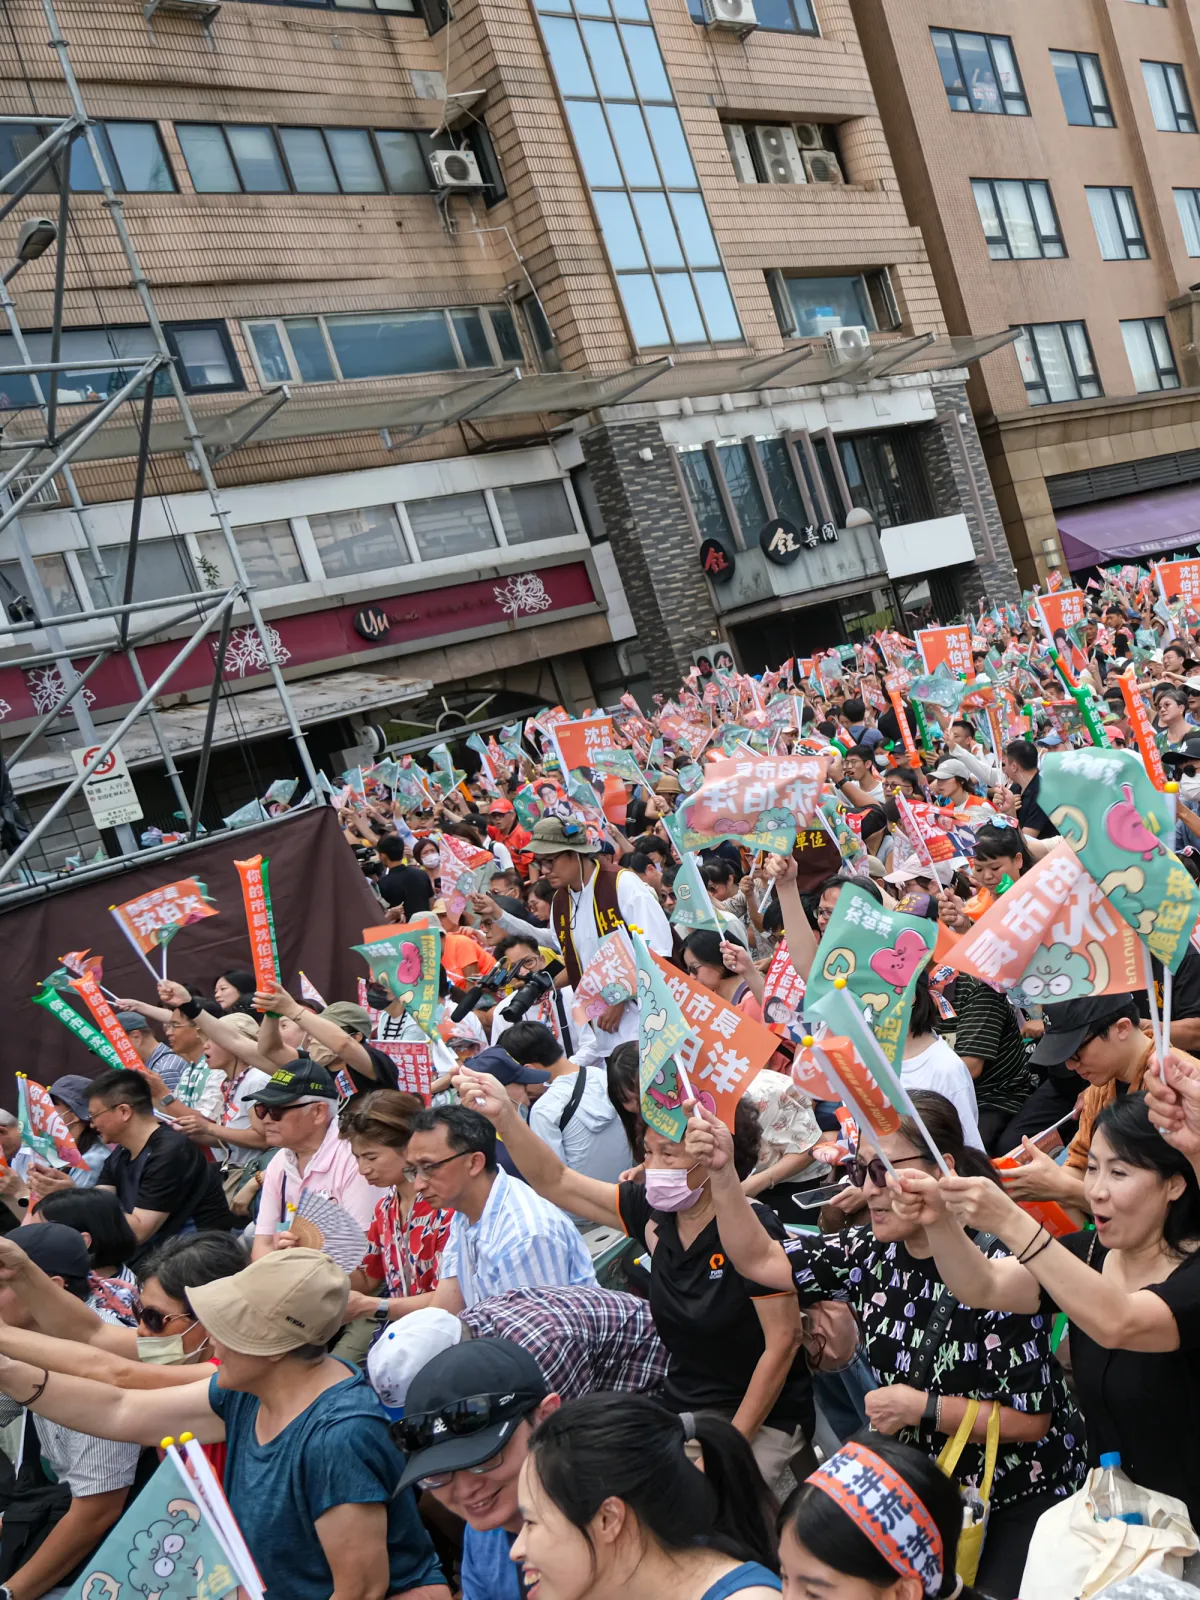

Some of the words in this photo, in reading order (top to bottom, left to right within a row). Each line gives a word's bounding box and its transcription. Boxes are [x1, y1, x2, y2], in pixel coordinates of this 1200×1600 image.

[1060, 598, 1074, 627] 沈伯
[98, 789, 132, 801] SIDEWALK
[796, 831, 827, 851] 單位
[244, 869, 273, 970] 你的市長沈伯洋
[660, 969, 741, 1040] 的市長
[31, 1106, 69, 1141] 沈伯
